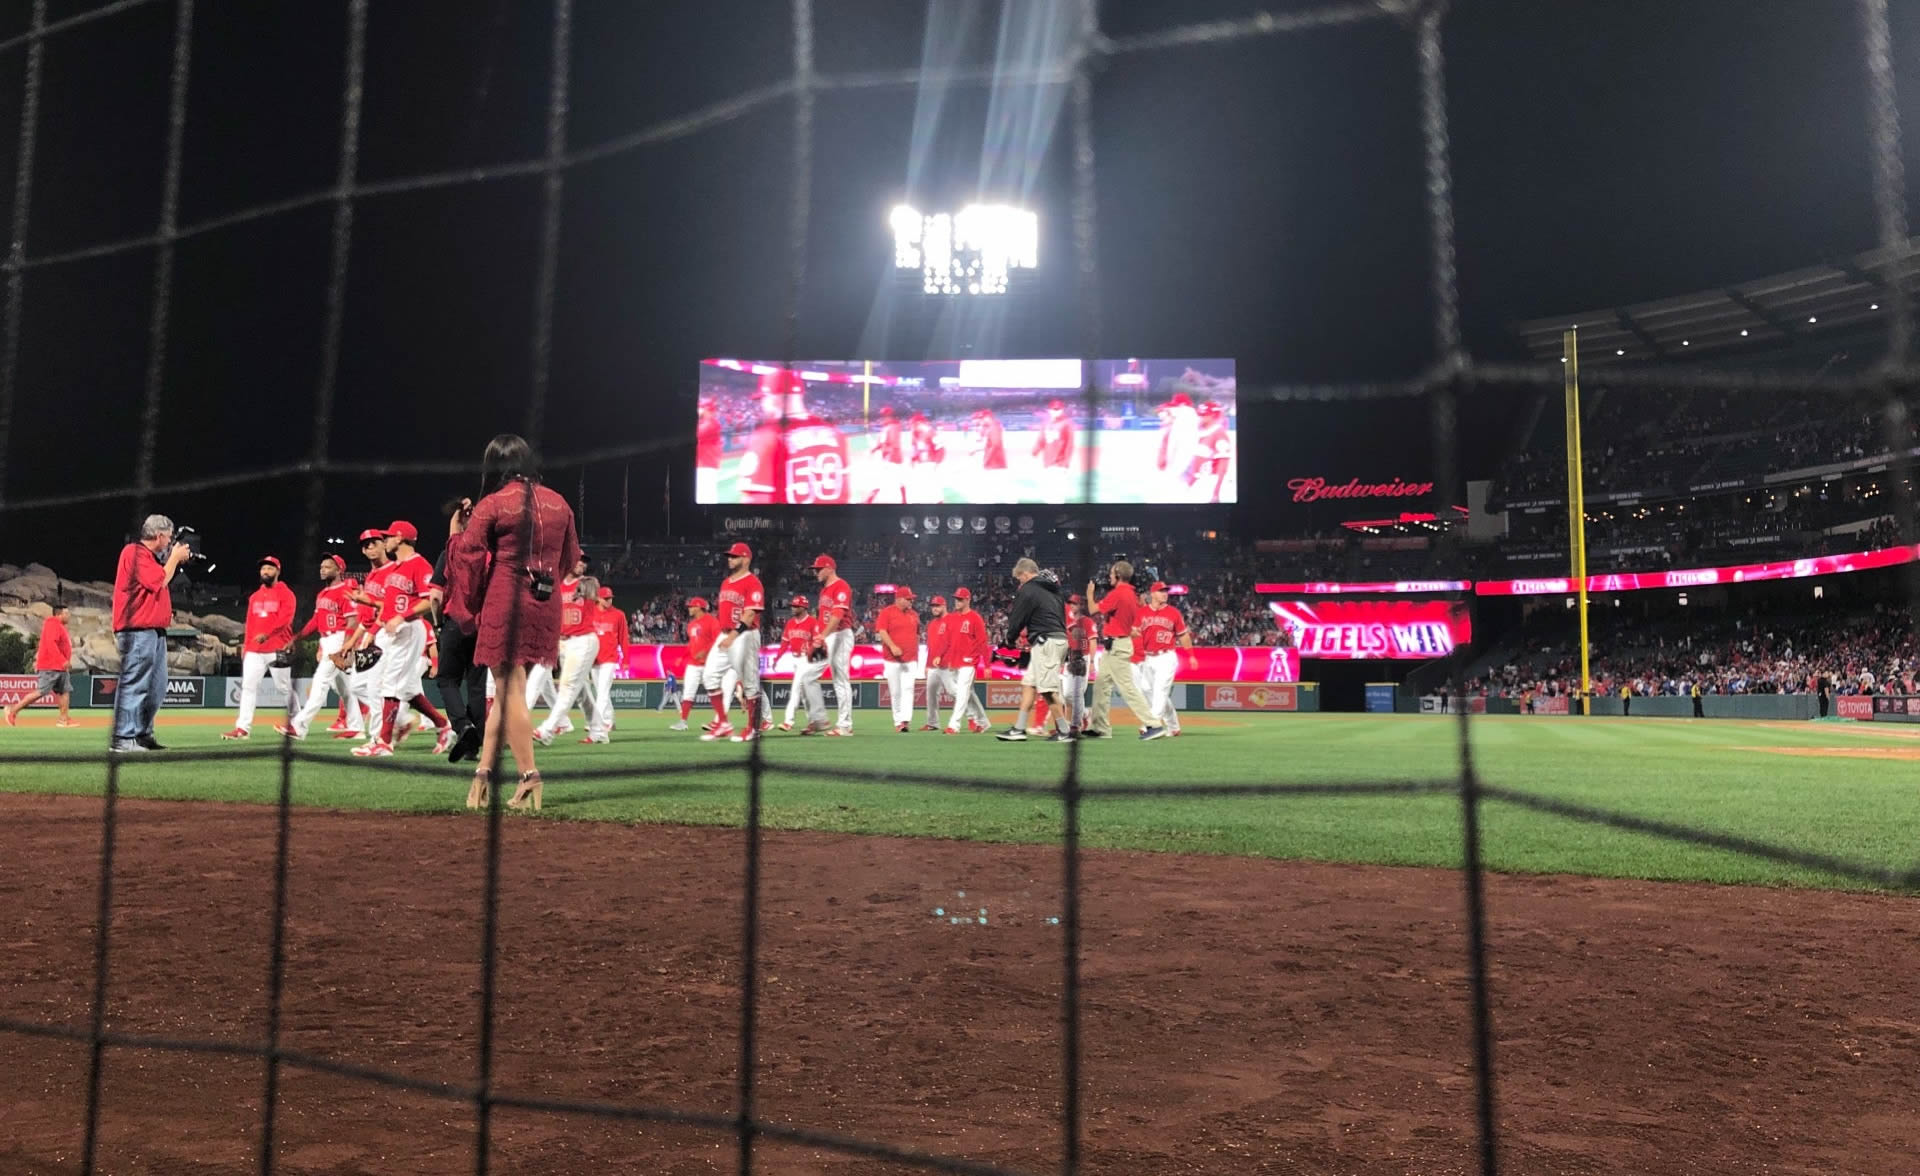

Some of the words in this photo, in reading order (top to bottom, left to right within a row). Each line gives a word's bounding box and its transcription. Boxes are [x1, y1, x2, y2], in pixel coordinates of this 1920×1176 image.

[1287, 477, 1434, 503] Budweiser
[395, 594, 409, 614] 3
[326, 613, 337, 629] 8
[1156, 630, 1174, 645] 27
[1390, 624, 1450, 653] WIN
[1847, 702, 1872, 714] TOYOTA
